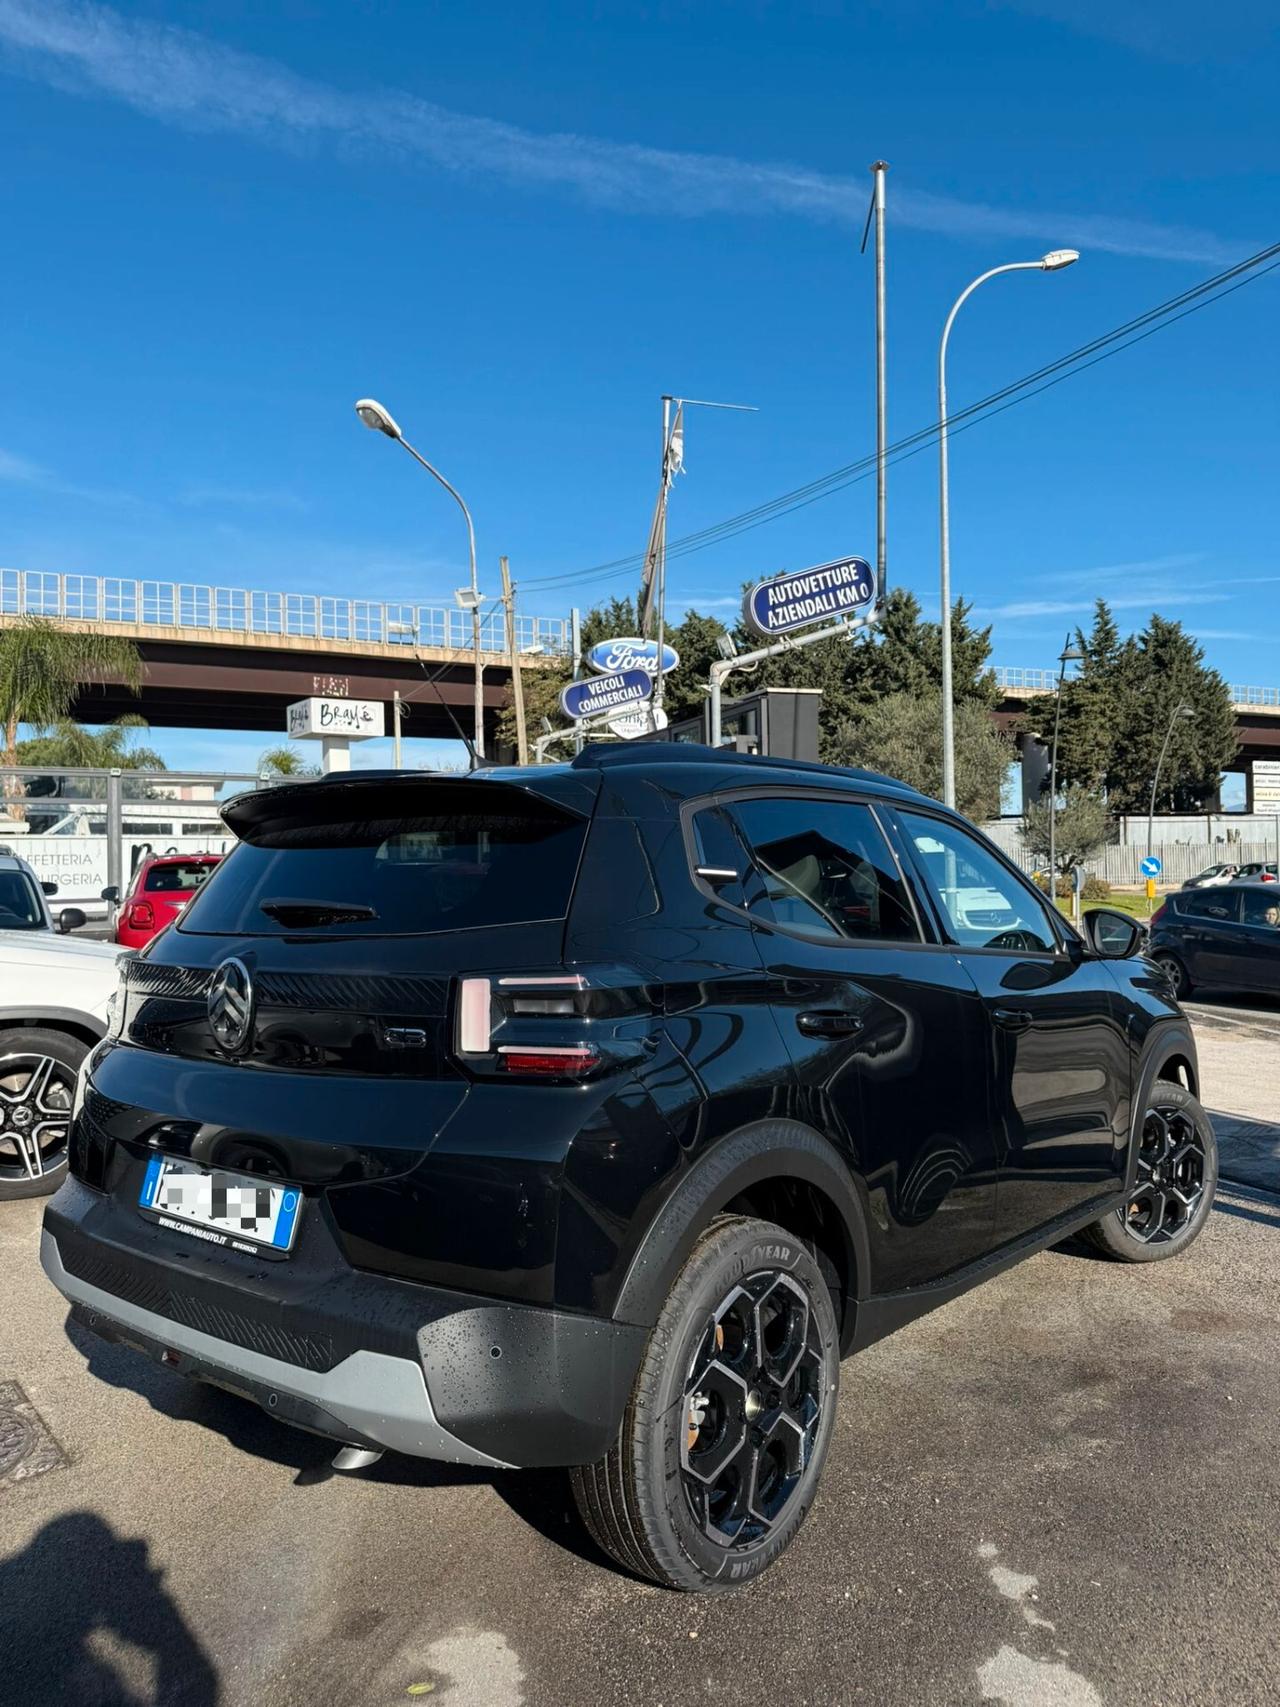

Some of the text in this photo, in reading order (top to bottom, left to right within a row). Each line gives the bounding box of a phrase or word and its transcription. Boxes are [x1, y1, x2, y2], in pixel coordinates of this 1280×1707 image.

[768, 563, 859, 606] AUTOVETTURE
[767, 591, 837, 628] AZIENDALI
[836, 585, 859, 607] KM
[606, 642, 660, 670] Ford
[578, 685, 644, 713] COMMERCIALI
[588, 675, 625, 695] VEICOLI
[26, 854, 93, 865] FFETTERIA
[38, 873, 103, 886] URGERIA
